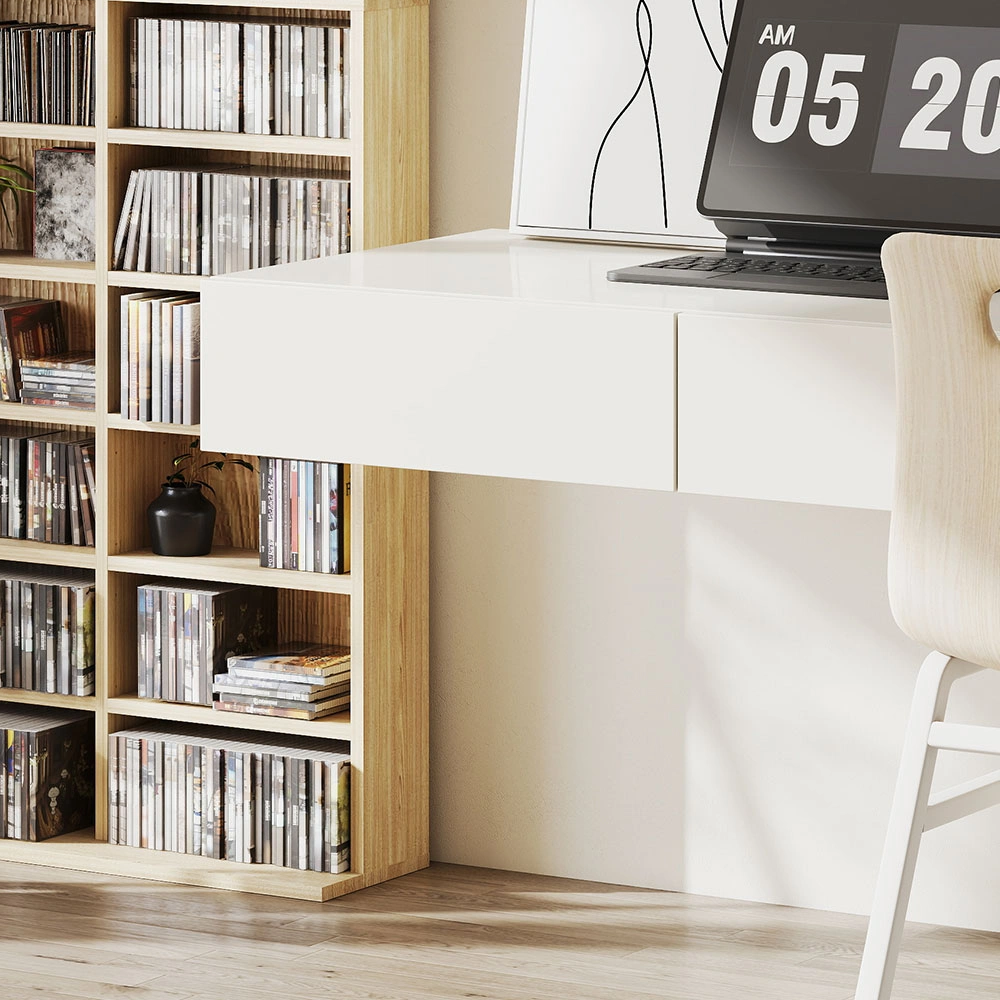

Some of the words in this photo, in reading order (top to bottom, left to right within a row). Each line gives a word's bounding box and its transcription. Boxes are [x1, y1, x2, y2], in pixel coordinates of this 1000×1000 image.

[758, 23, 796, 46] AM
[751, 50, 866, 147] 05
[899, 56, 1000, 155] 20
